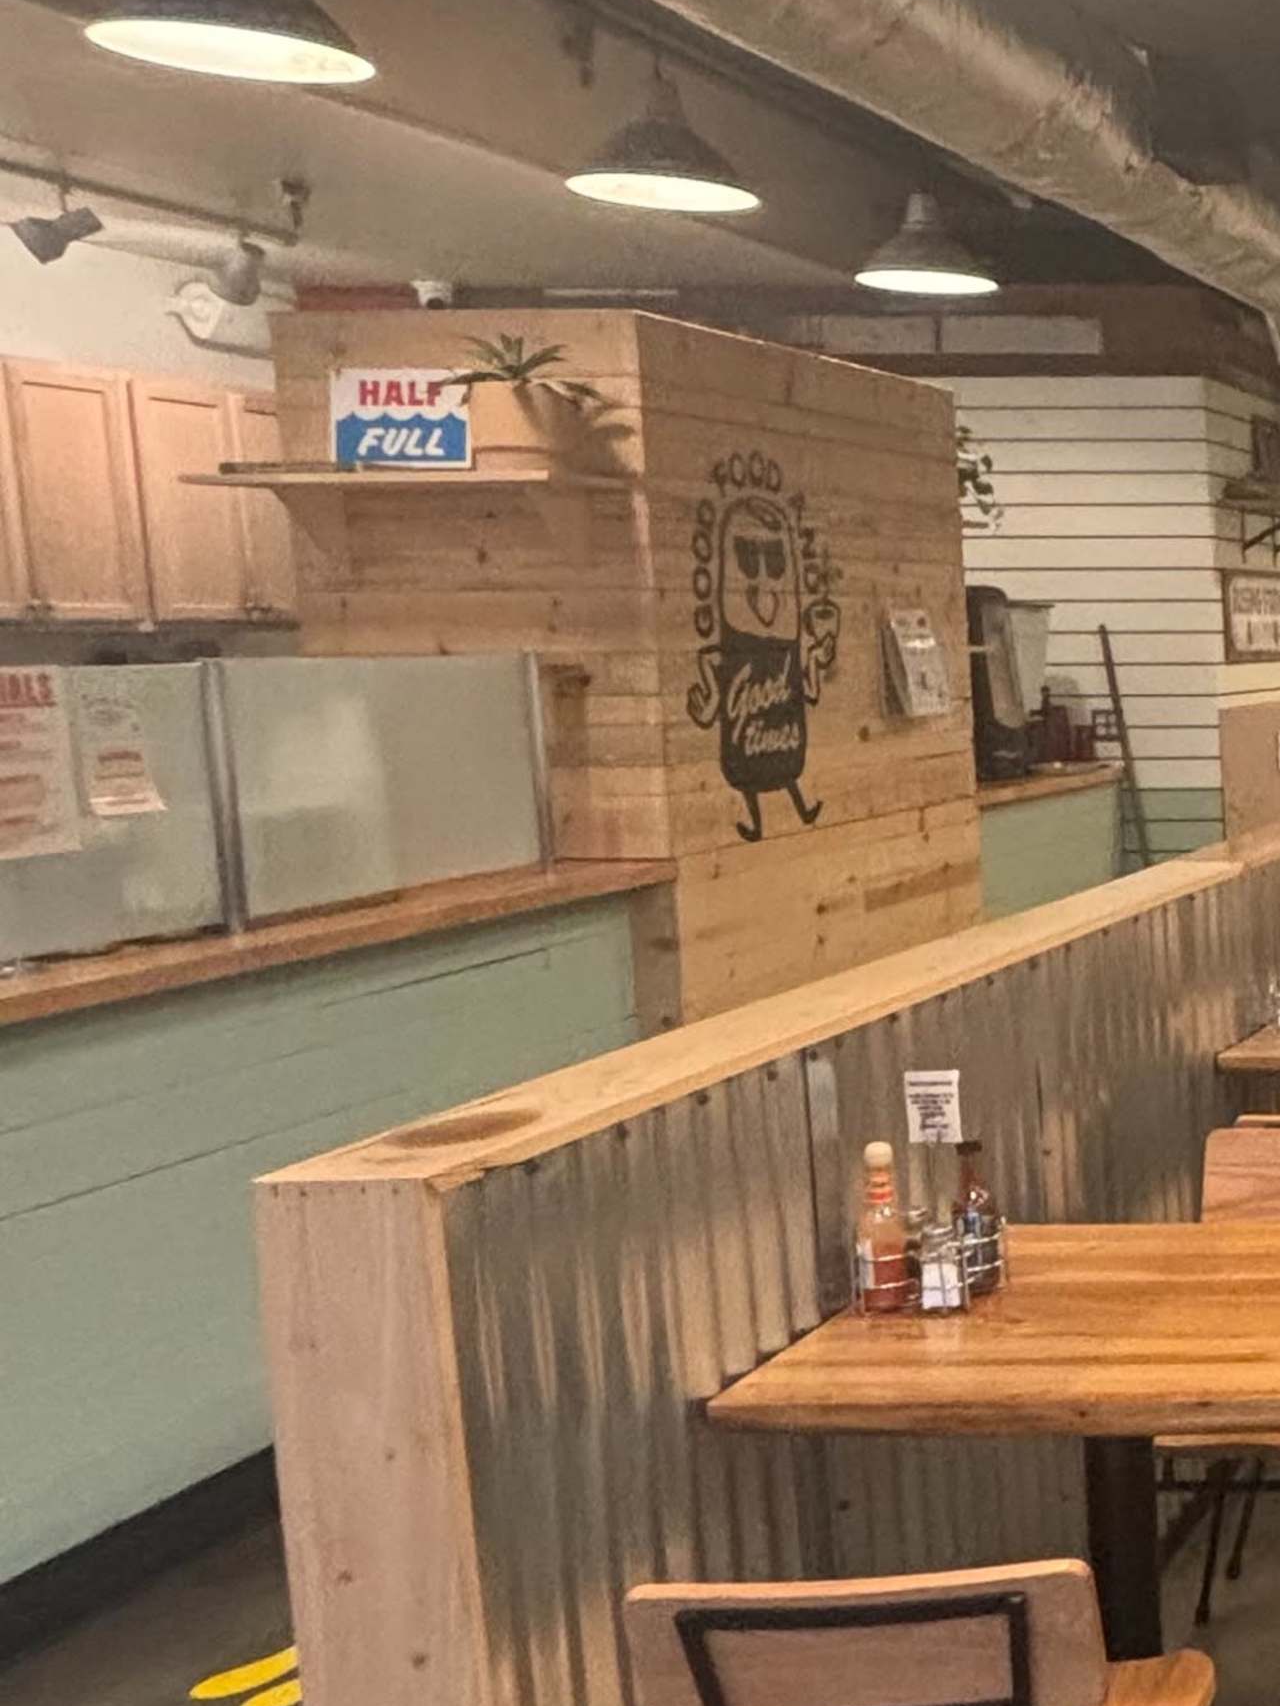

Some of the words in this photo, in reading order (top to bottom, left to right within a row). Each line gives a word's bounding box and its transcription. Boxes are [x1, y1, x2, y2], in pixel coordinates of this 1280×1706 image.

[359, 380, 441, 406] HALF
[357, 427, 445, 456] FULL
[692, 498, 716, 638] GOOD
[707, 450, 781, 498] FOOD
[727, 652, 791, 744] Good
[744, 719, 800, 756] times
